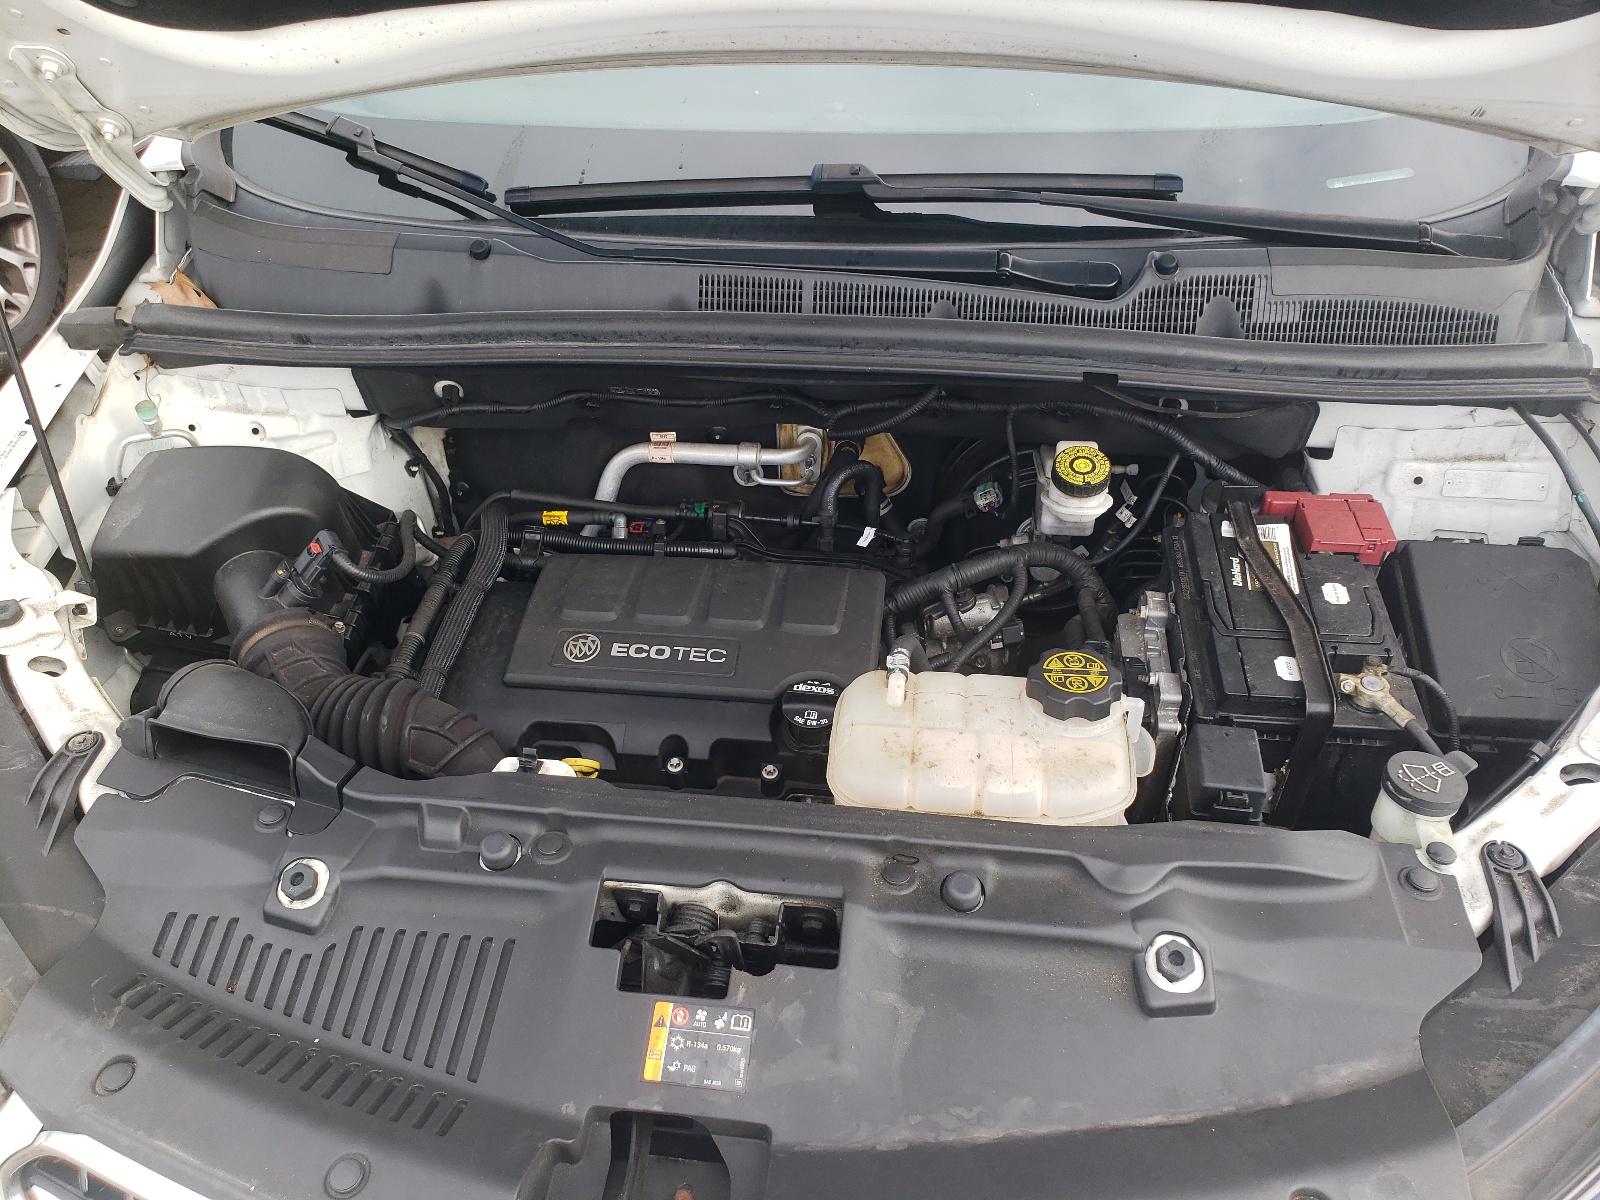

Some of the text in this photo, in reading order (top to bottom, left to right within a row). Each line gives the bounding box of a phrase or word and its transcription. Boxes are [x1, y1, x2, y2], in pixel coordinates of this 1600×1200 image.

[1230, 557, 1243, 587] DieHard
[610, 643, 728, 663] ECOTEC
[793, 683, 834, 694] dexos
[686, 1041, 742, 1054] R-134a 0.570kg
[683, 1064, 697, 1073] PAG
